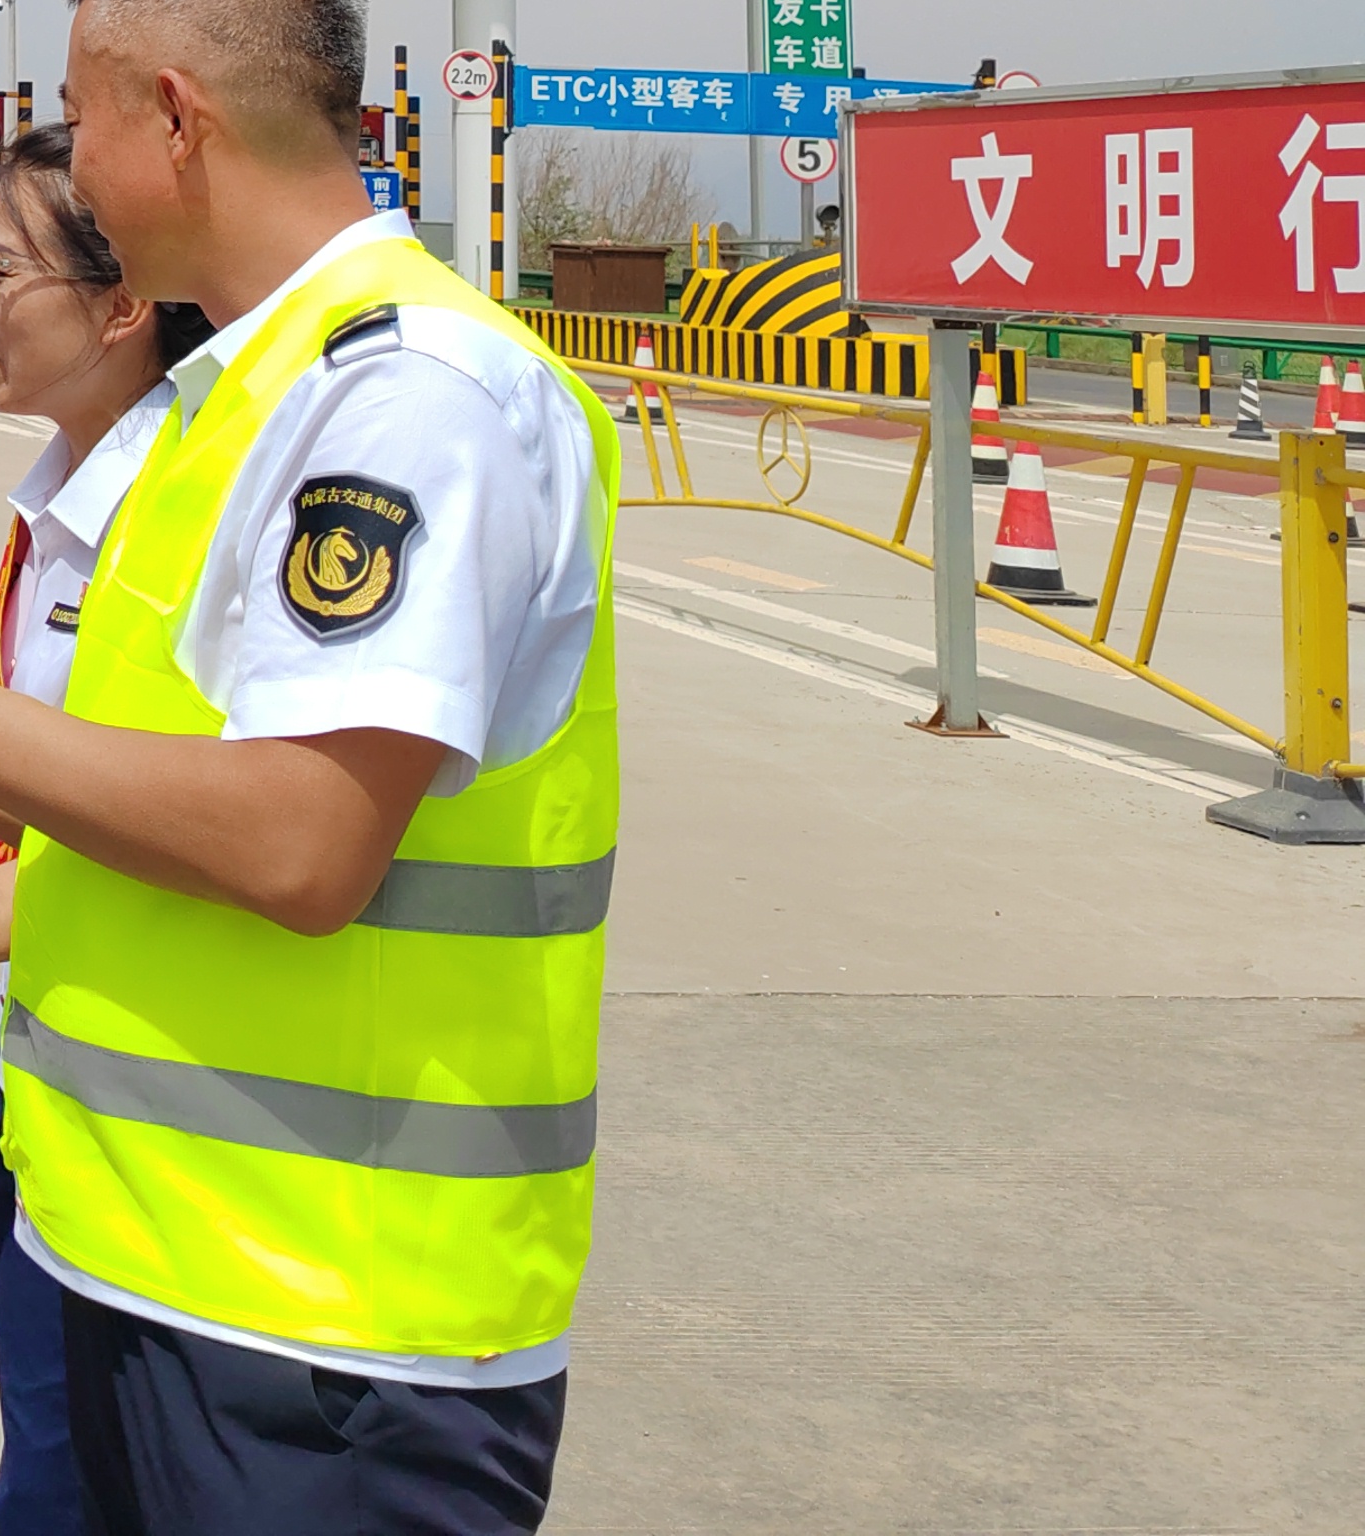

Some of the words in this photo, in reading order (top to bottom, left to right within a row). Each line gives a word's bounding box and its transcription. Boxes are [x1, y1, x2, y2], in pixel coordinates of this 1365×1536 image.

[772, 35, 844, 70] 车道
[451, 67, 488, 86] 2.2m
[531, 75, 734, 110] ETC小型客车
[797, 139, 821, 172] 5
[950, 113, 1365, 293] 文明行
[301, 486, 407, 526] 内蒙古交通集团
